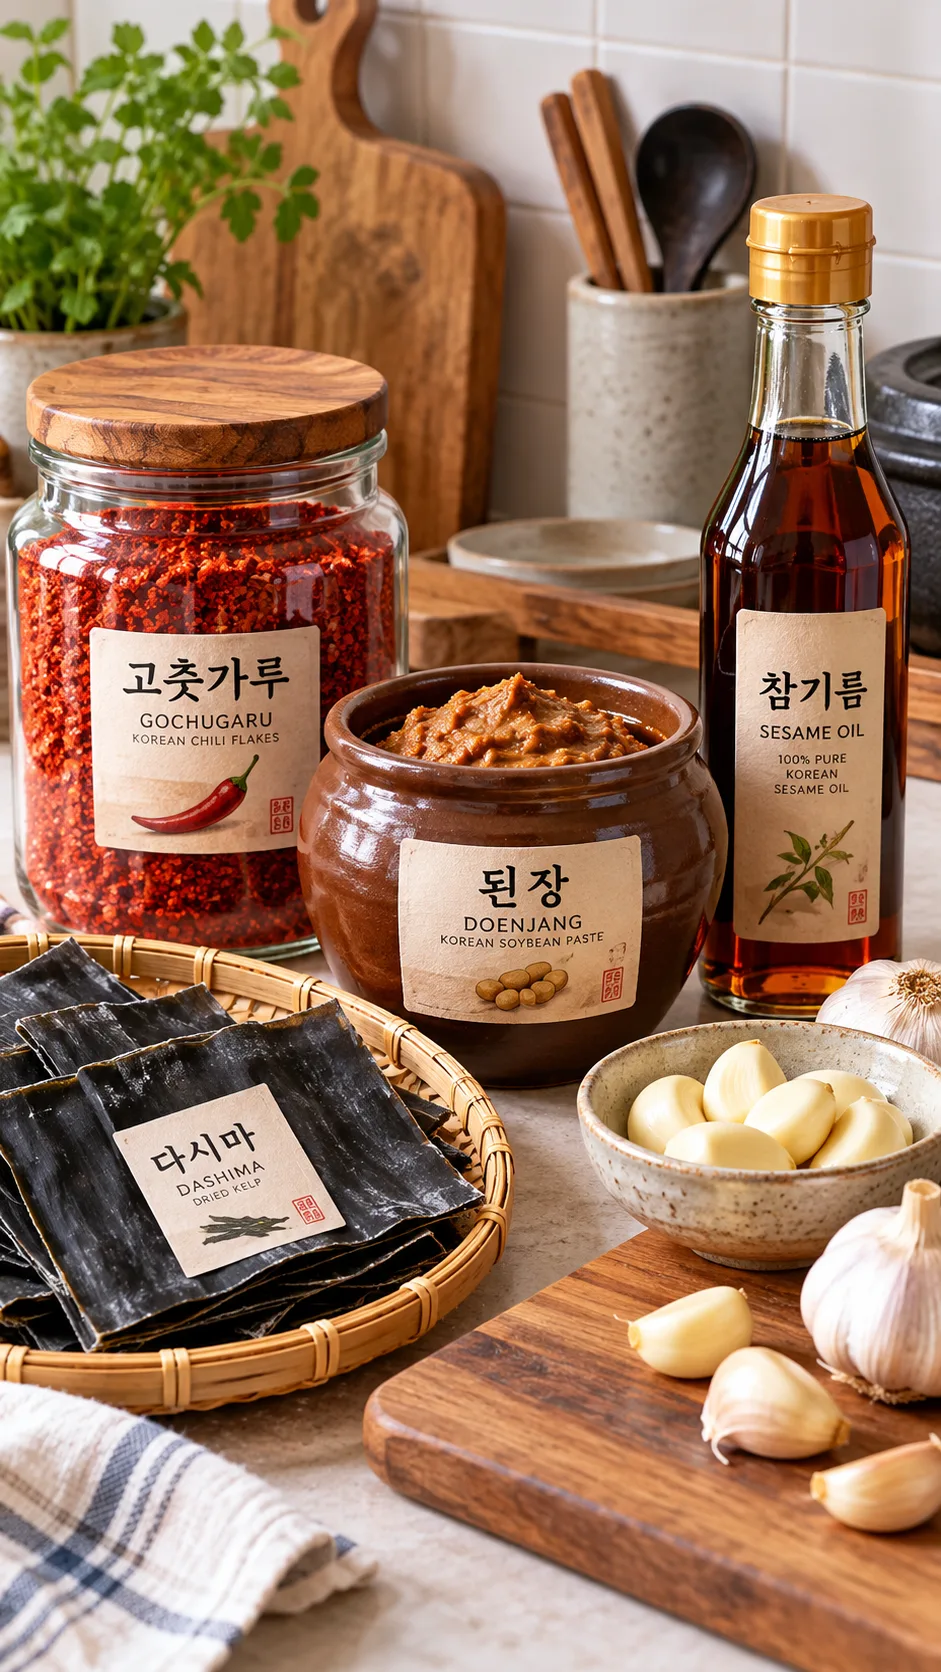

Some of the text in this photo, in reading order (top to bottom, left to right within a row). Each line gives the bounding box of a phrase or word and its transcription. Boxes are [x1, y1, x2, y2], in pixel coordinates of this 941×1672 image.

[123, 656, 290, 702] 고춧가루
[759, 671, 867, 711] 참기름
[140, 712, 272, 729] GOCHUGARU
[133, 733, 279, 746] KOREAN CHILI FLAKES
[760, 723, 864, 740] SESAME OIL
[779, 753, 846, 764] 100% PURE
[787, 769, 838, 779] KOREAN
[775, 784, 849, 794] SESAME OIL
[478, 864, 569, 908] 된장
[464, 914, 582, 933] DOENJANG
[441, 932, 605, 948] KOREAN SOYBEAN PASTE
[150, 1122, 255, 1174] 다시마
[176, 1160, 265, 1197] DASHIMA
[193, 1178, 262, 1206] DRIED KELP
